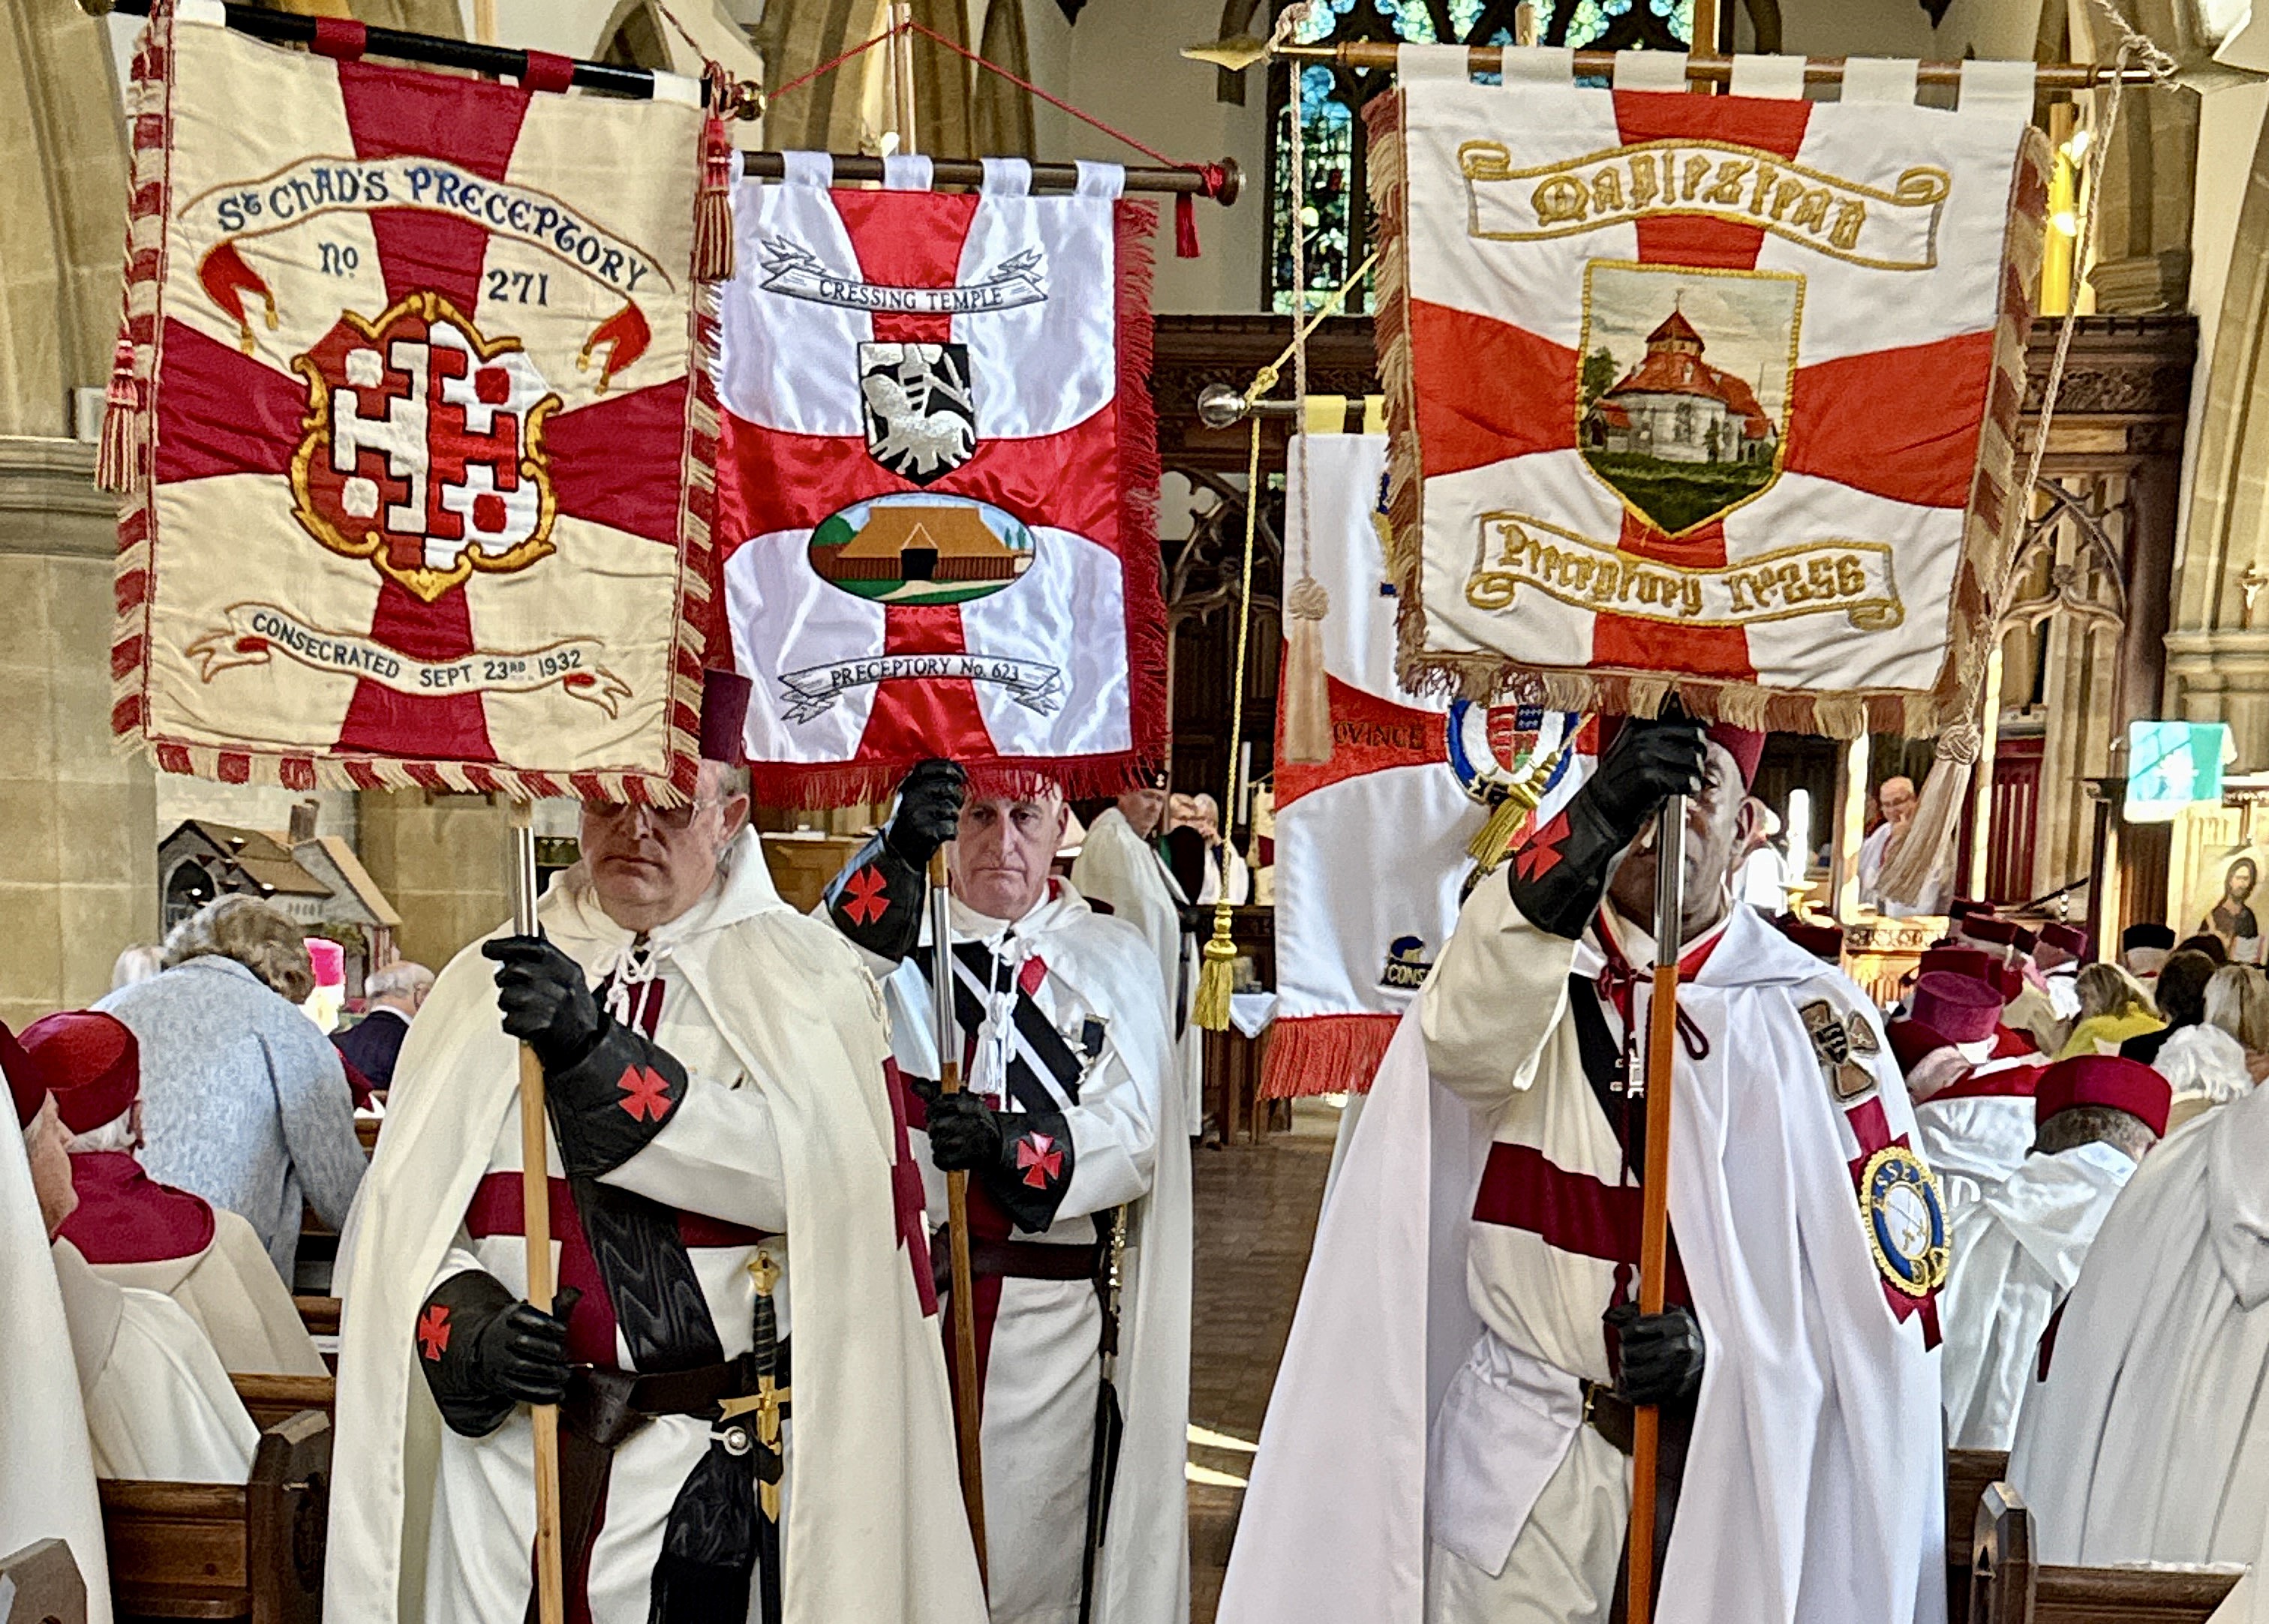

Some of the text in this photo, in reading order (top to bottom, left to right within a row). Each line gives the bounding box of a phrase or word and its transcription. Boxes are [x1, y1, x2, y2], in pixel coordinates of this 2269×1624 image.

[403, 166, 648, 292] PRECEPTORY
[487, 269, 549, 307] 271
[819, 280, 1004, 311] CRESSING TEMPLE
[1497, 524, 1703, 617] Preceptory
[1777, 554, 1866, 605] 256
[251, 613, 400, 679] CONSECRATED
[419, 664, 473, 687] SEPT
[537, 649, 582, 677] 1932
[831, 657, 1019, 688] PRECEPTORY No. 623
[1333, 721, 1425, 749] OVINCE
[1387, 964, 1426, 986] CONS
